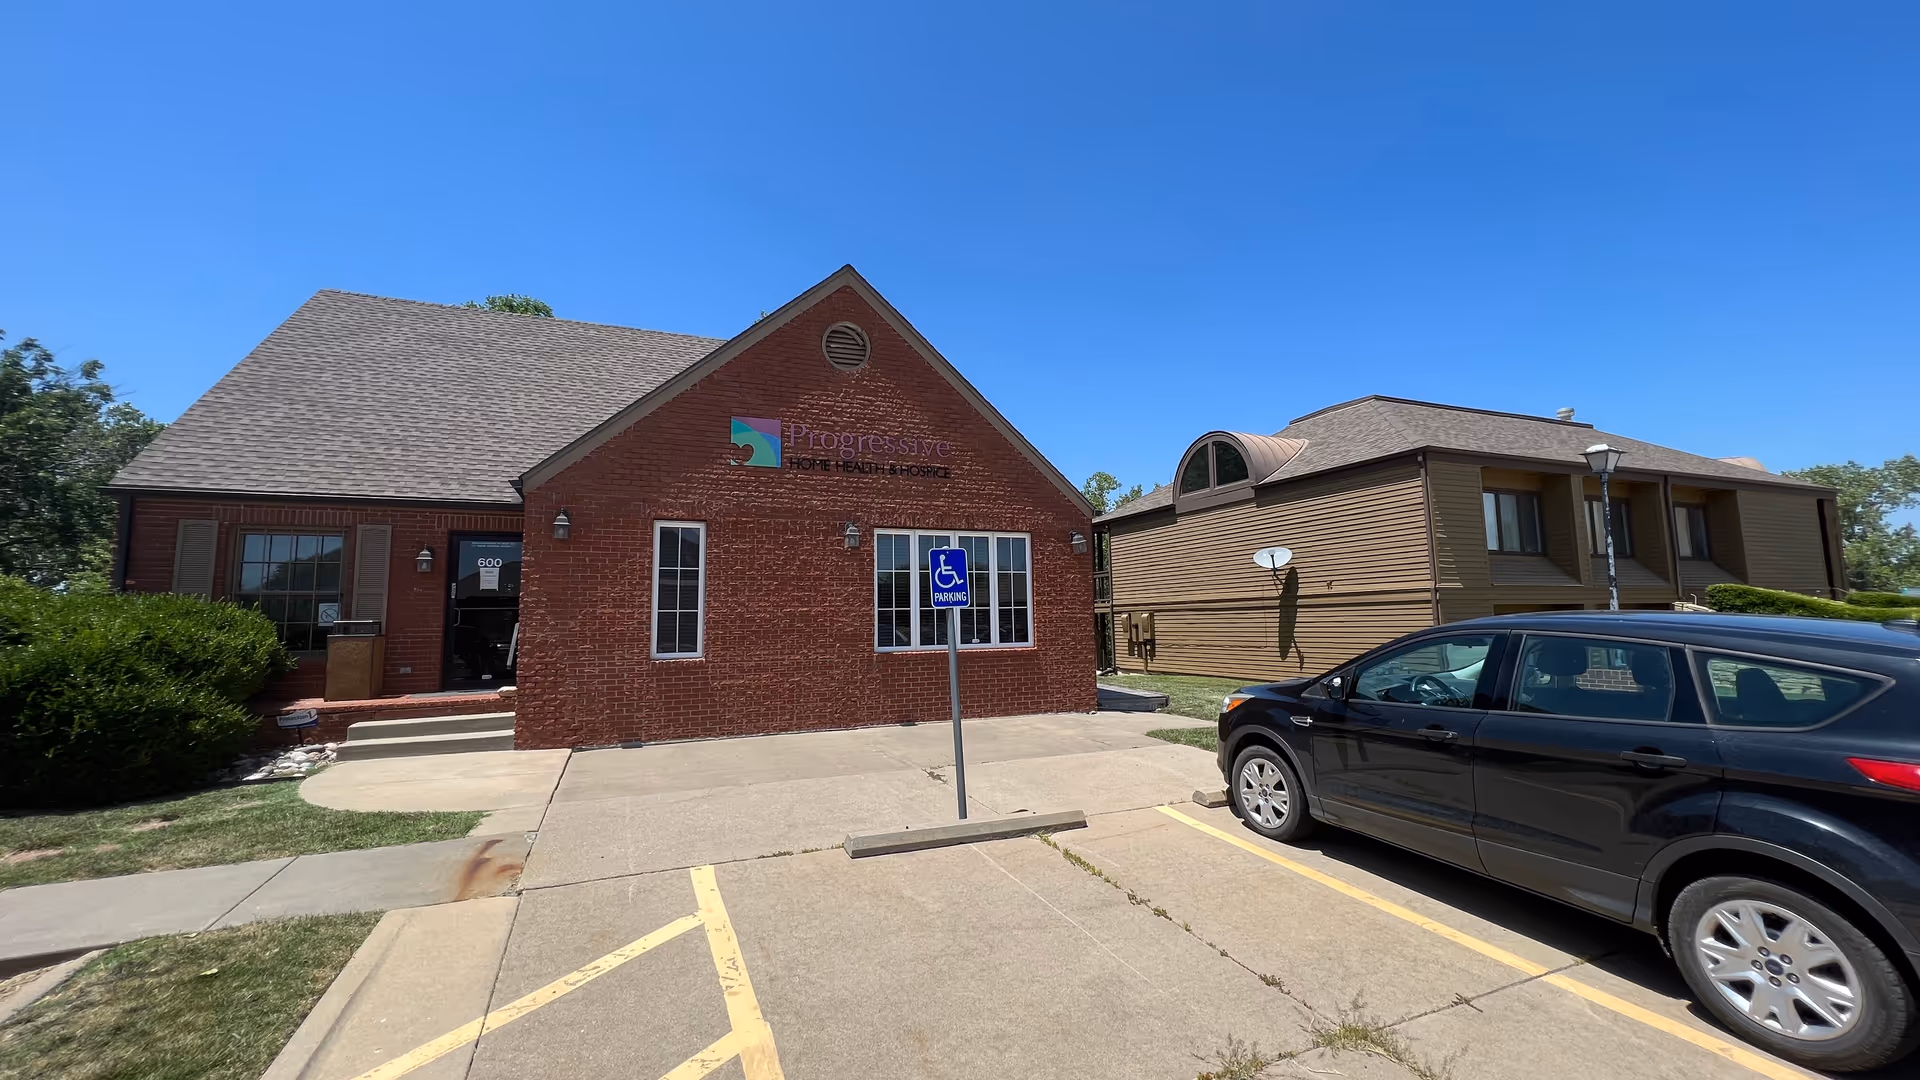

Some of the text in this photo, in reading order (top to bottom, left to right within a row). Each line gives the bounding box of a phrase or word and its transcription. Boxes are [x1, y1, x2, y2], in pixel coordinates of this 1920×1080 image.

[789, 423, 950, 460] Progressive
[789, 457, 950, 479] HOME HEALTH & HOSPICE
[478, 557, 502, 567] 600
[934, 592, 967, 602] PARKING
